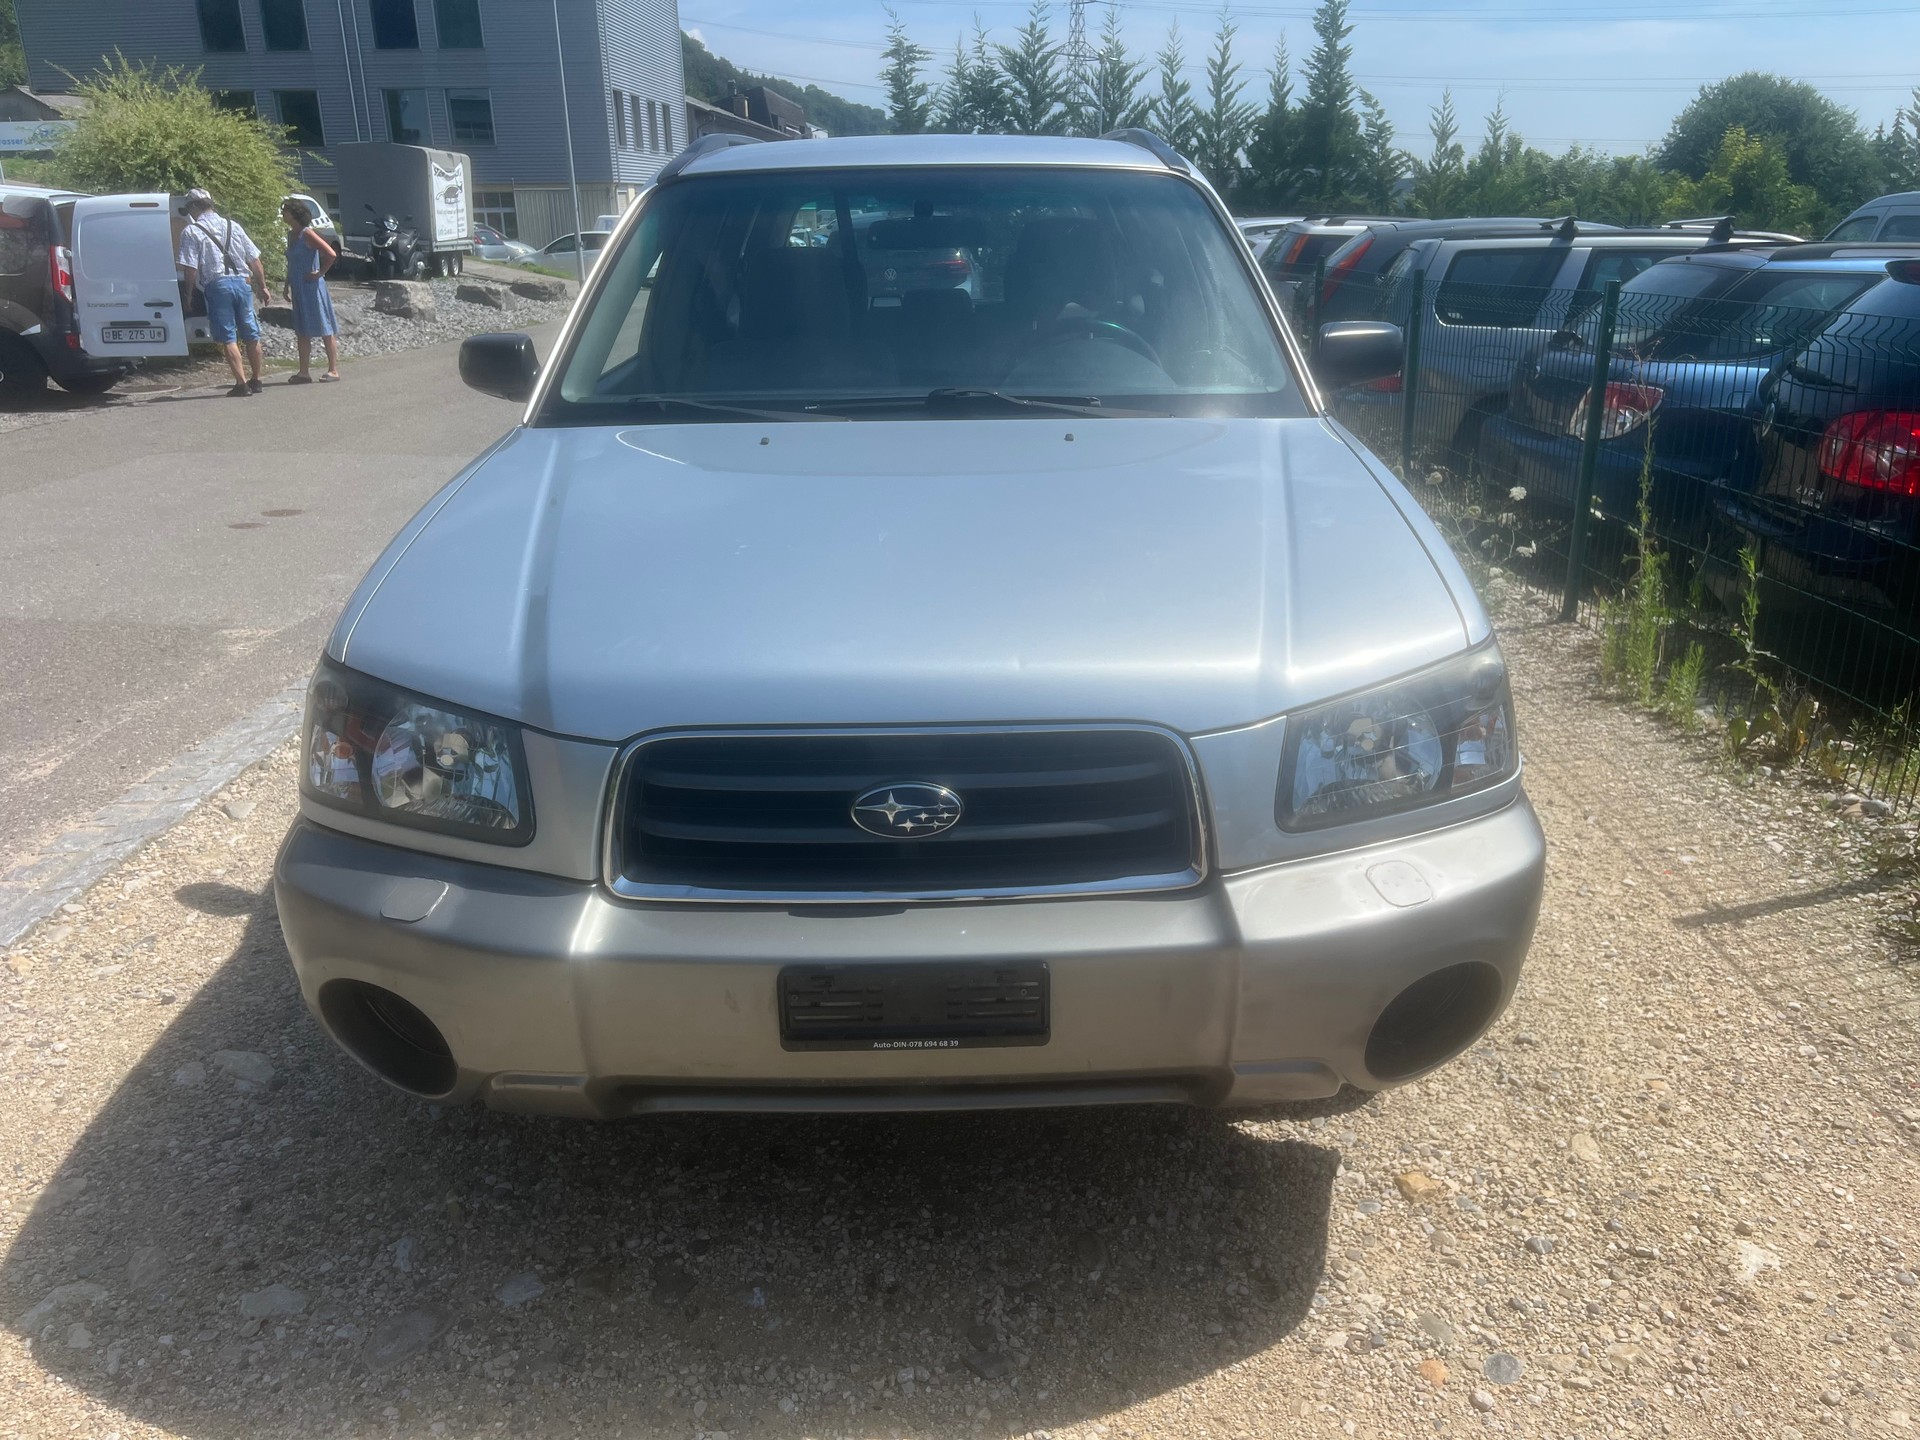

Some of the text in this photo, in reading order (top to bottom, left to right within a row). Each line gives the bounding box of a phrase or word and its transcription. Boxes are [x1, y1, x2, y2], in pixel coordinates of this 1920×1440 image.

[112, 330, 155, 340] BE 275 U
